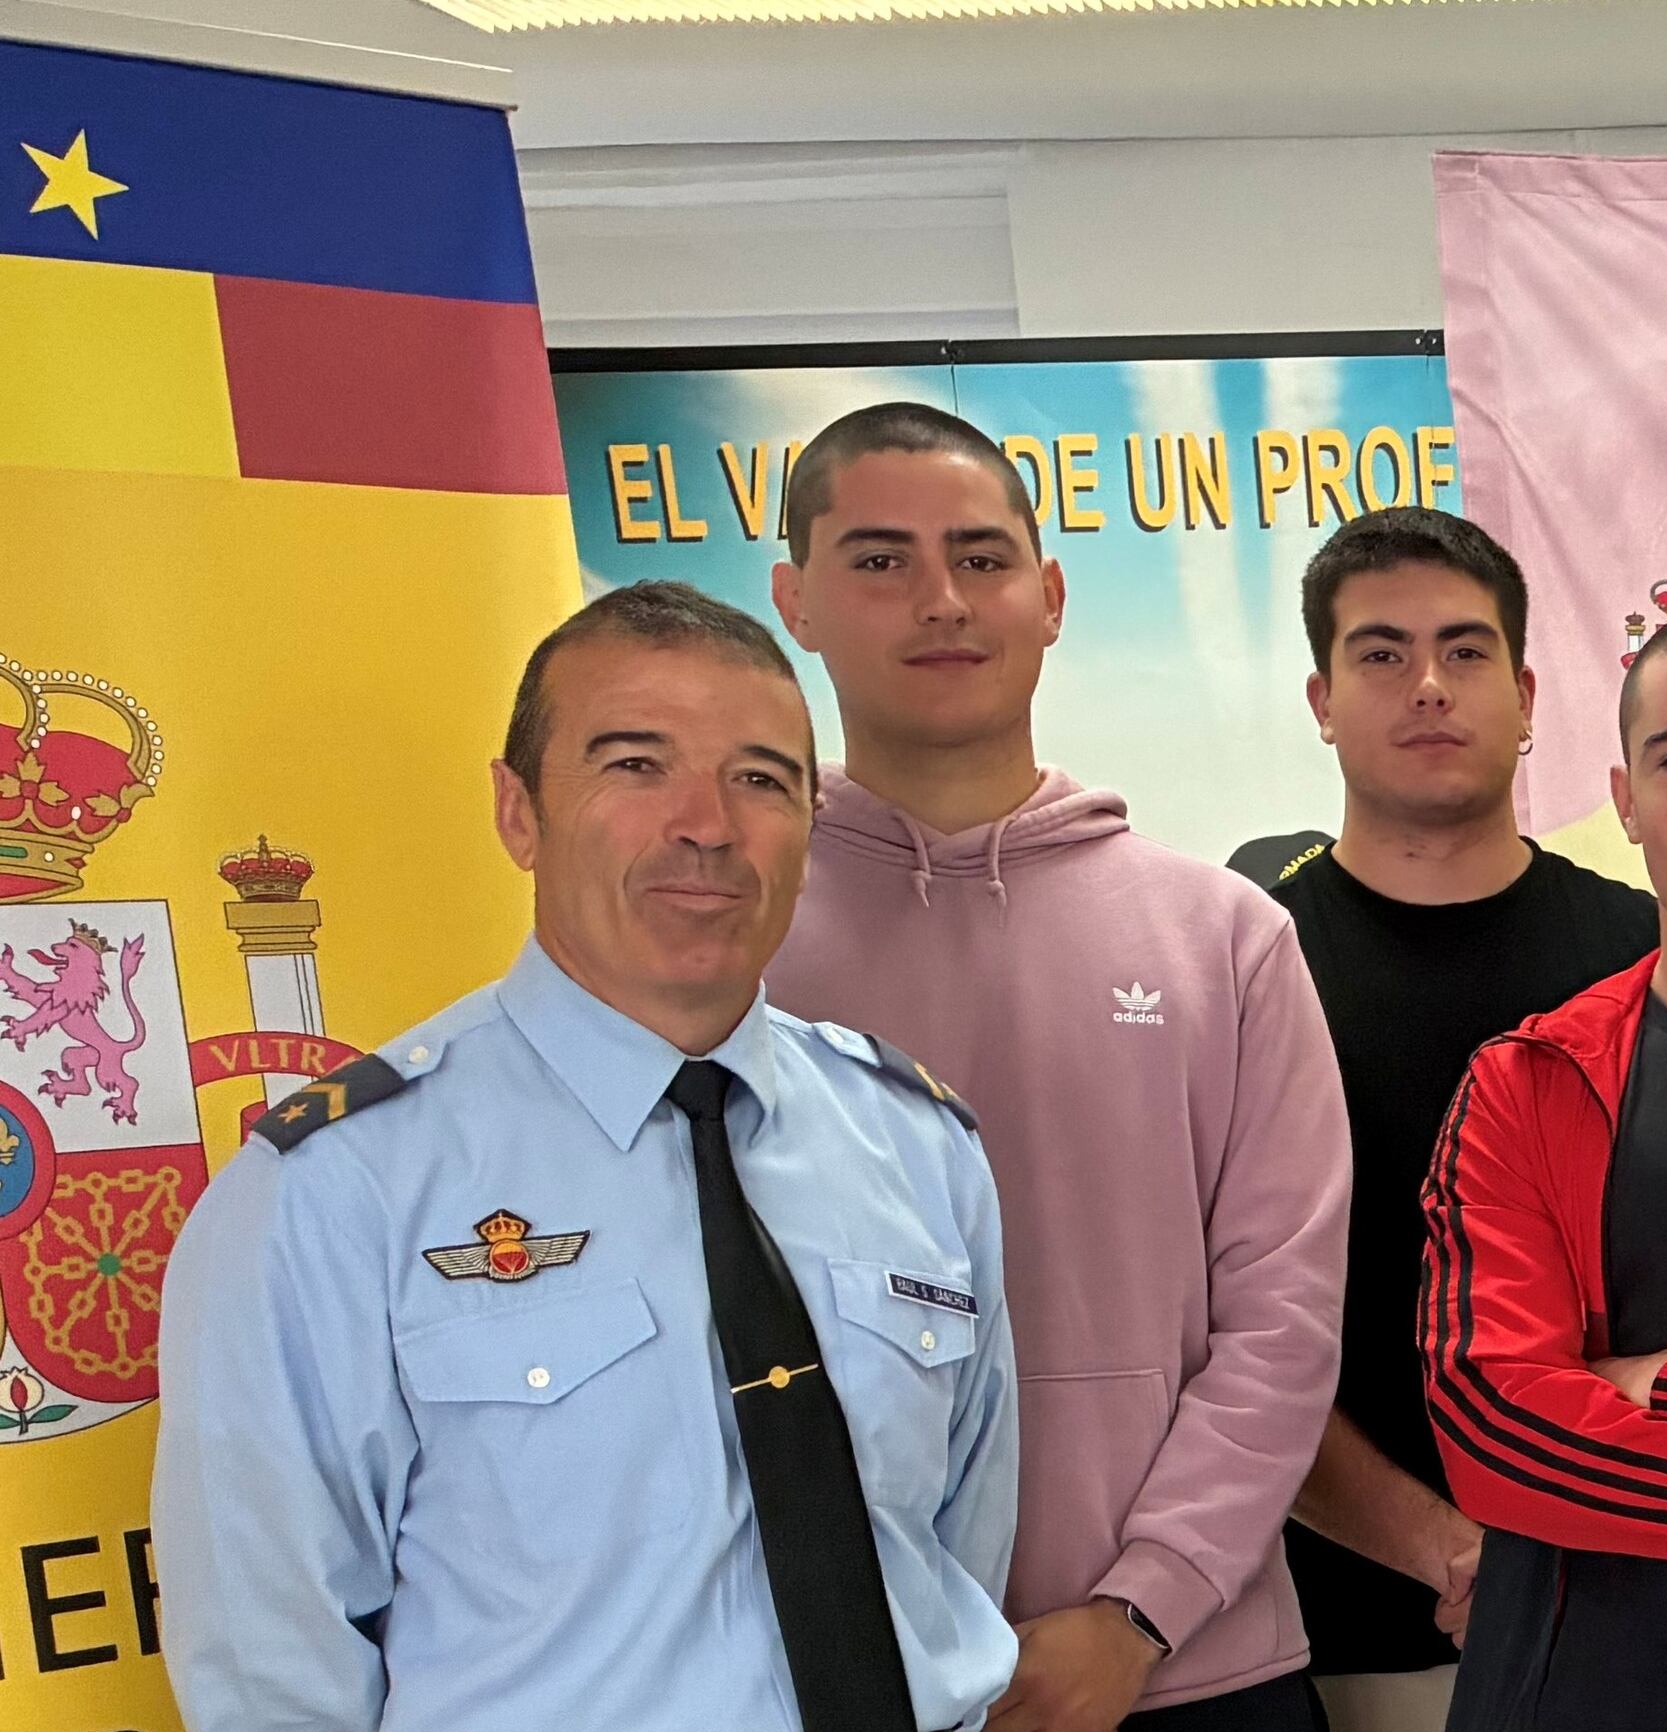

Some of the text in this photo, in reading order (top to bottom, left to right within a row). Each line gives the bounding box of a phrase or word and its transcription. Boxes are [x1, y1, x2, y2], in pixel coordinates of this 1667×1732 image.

[605, 443, 708, 543] EL
[1000, 434, 1104, 533] DE
[1127, 428, 1229, 531] UN
[1112, 1010, 1164, 1025] adidas
[207, 1038, 357, 1074] VLTR
